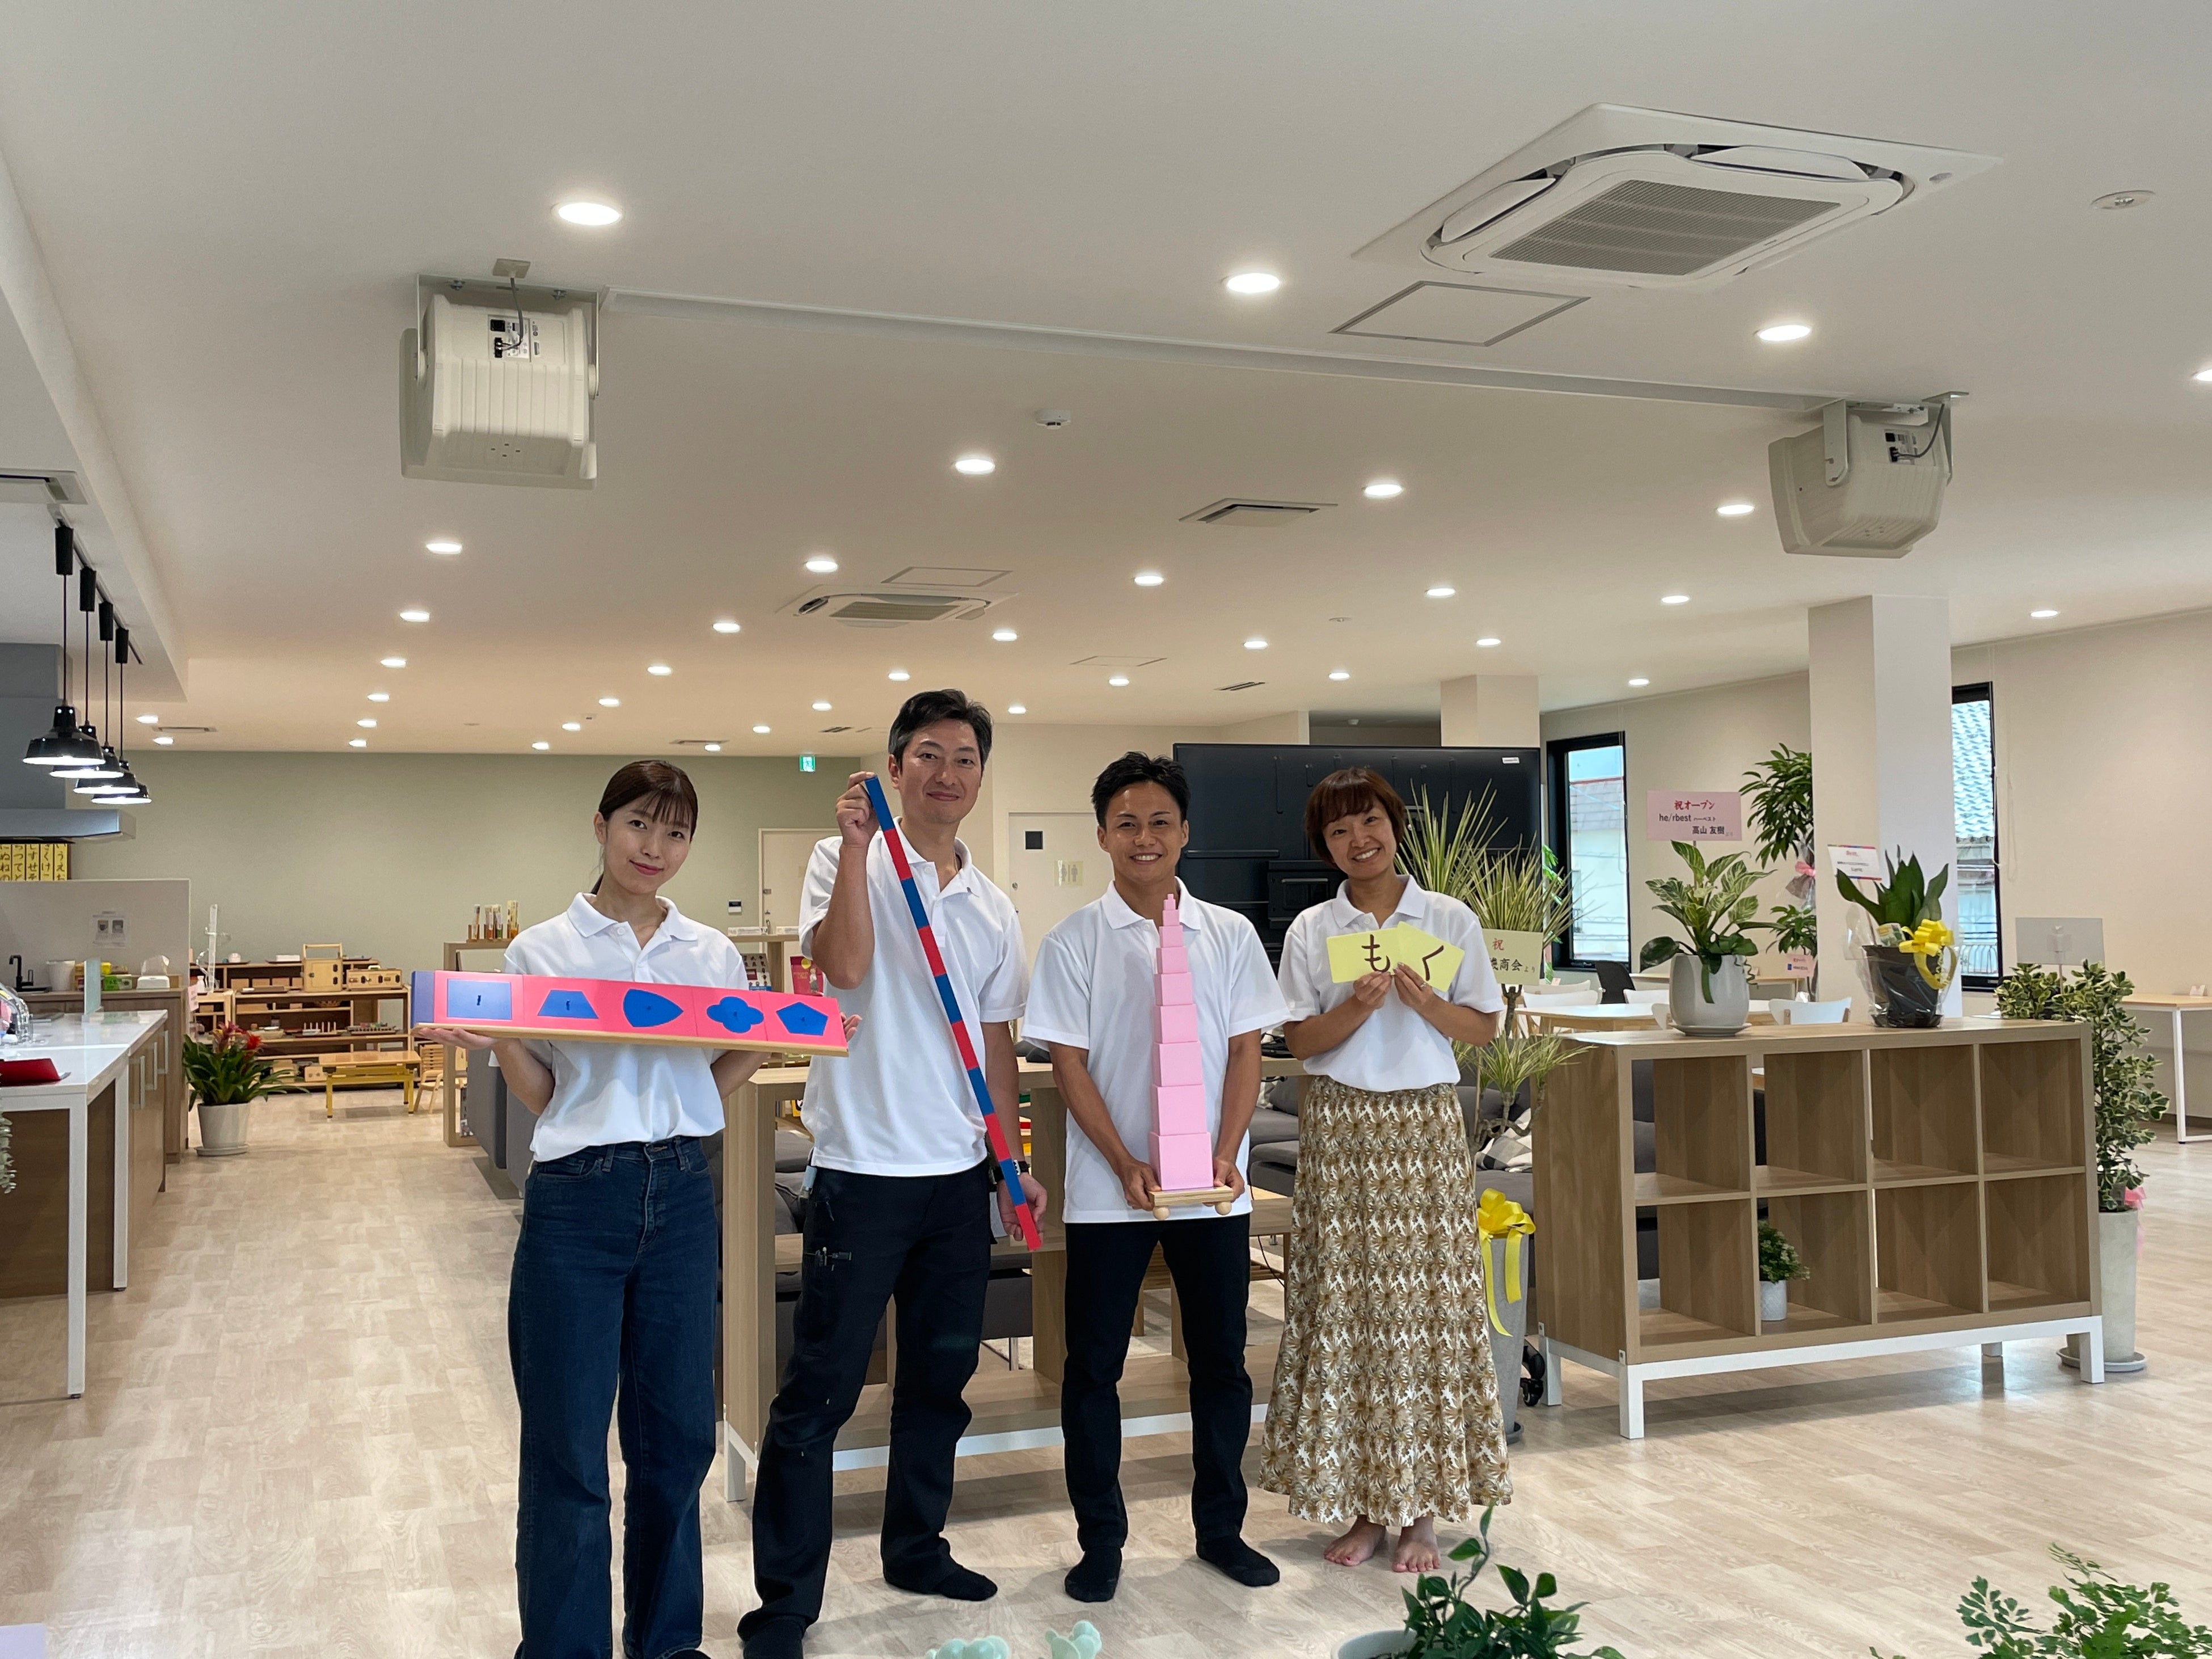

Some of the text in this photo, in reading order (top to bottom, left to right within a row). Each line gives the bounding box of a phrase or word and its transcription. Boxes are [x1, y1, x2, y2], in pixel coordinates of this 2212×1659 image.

[1674, 799, 1715, 810] 祝オープン
[1659, 813, 1691, 822] he/rbest
[1492, 938, 1504, 951] 祝
